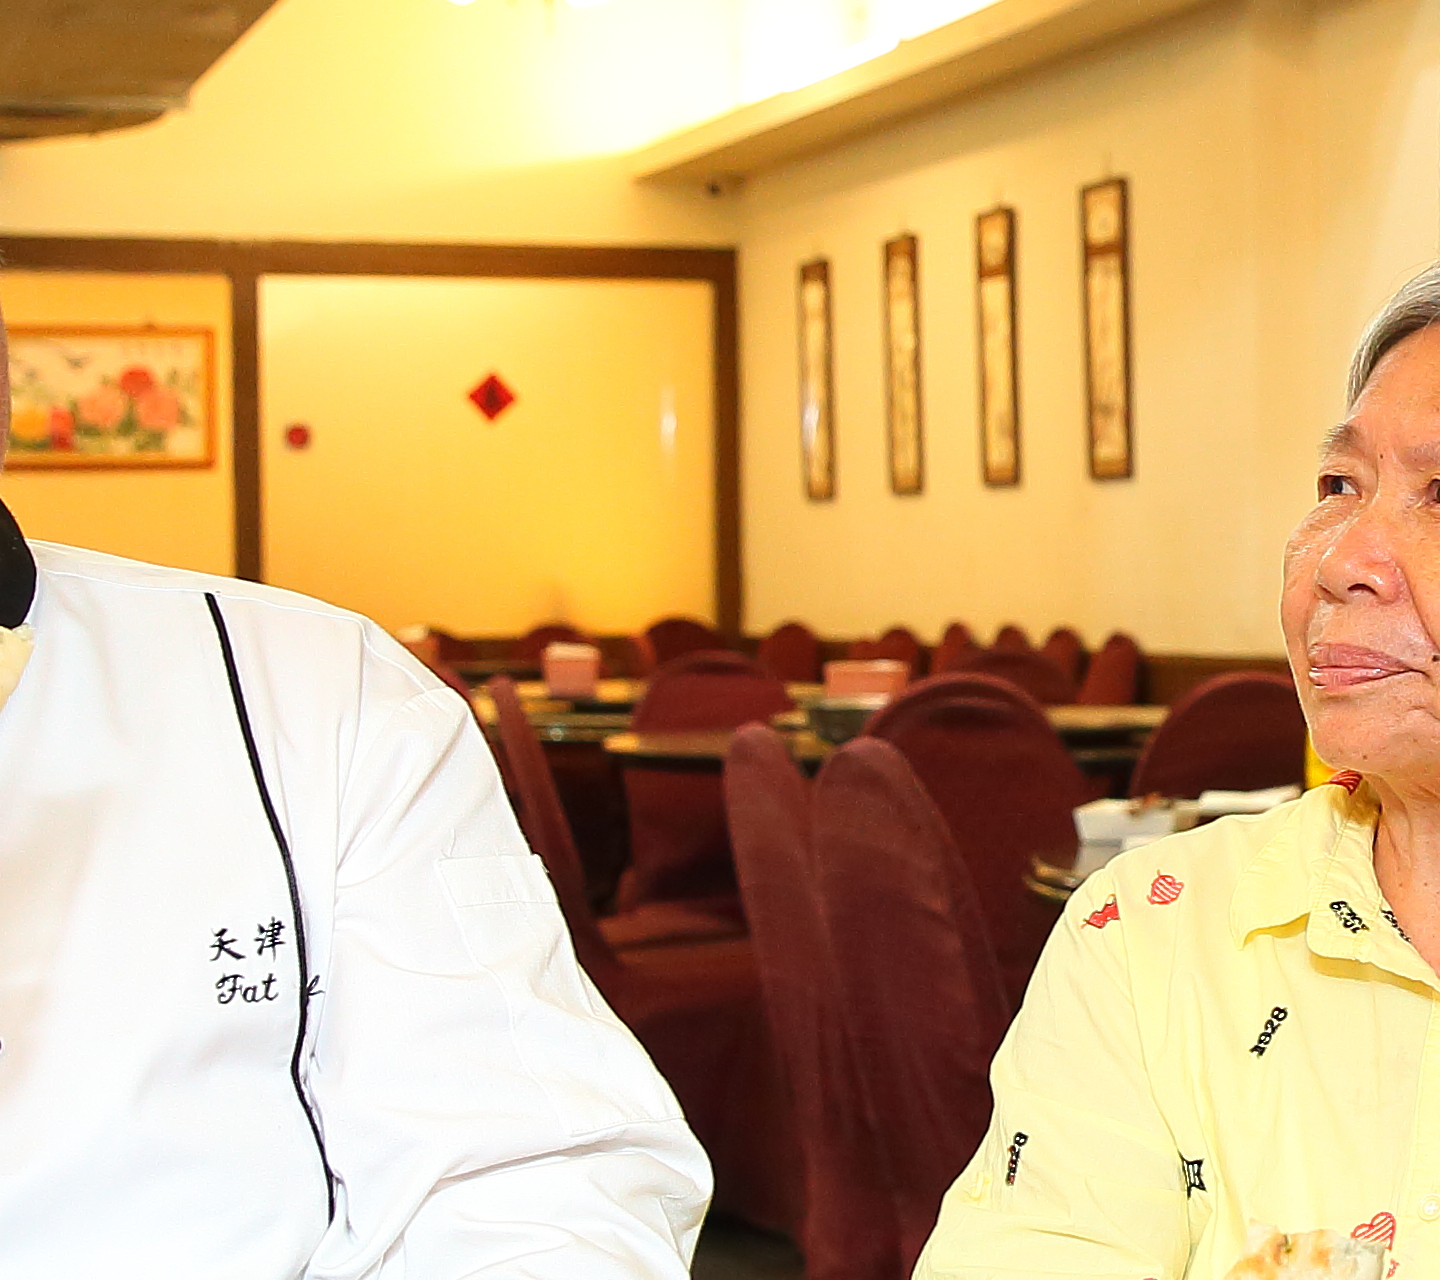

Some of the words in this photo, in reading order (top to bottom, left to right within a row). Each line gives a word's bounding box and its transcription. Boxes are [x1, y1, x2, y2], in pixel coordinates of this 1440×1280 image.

[209, 916, 287, 962] 天津
[215, 973, 279, 1005] Fat
[1248, 1006, 1288, 1059] 1928
